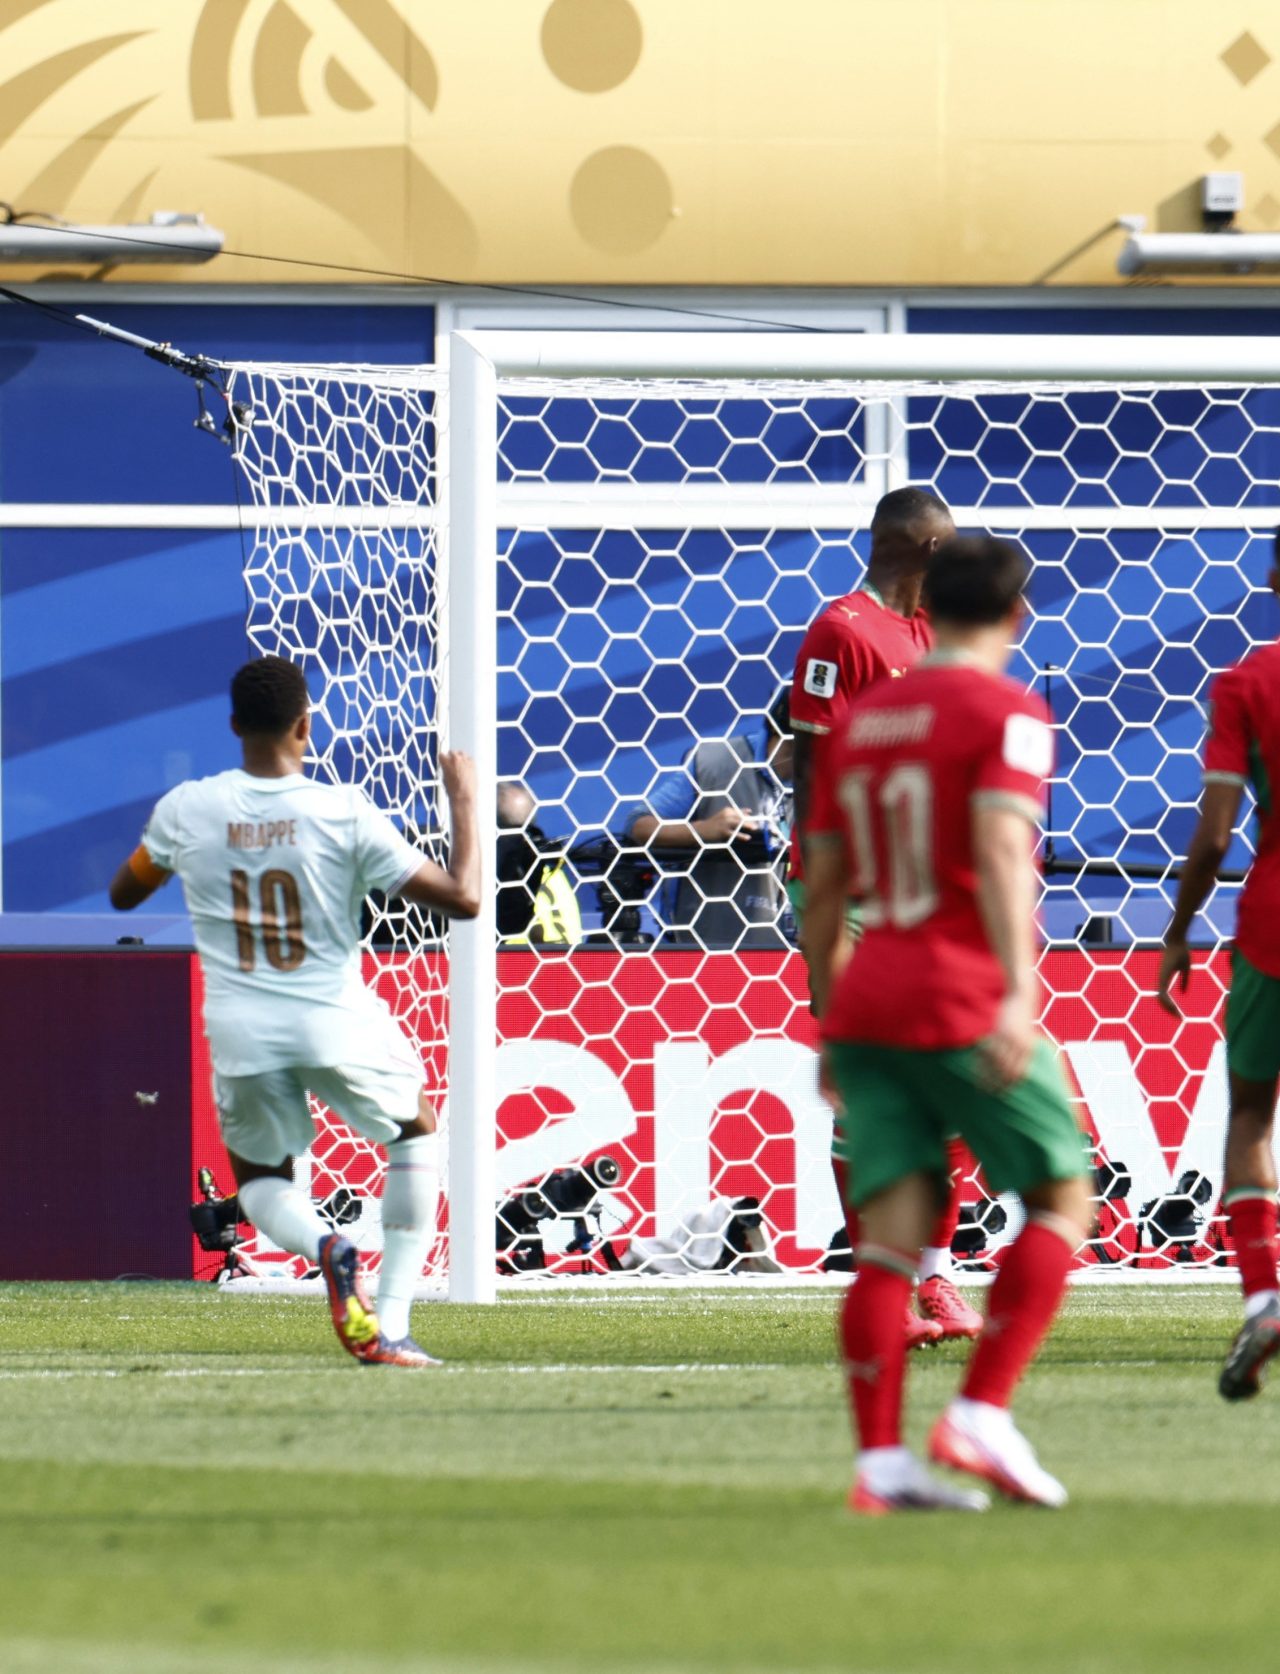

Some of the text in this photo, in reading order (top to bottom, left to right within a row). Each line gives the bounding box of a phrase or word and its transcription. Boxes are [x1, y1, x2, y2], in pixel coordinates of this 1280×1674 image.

[226, 819, 297, 849] MBAPPE
[837, 764, 939, 929] 10
[230, 868, 306, 972] 10
